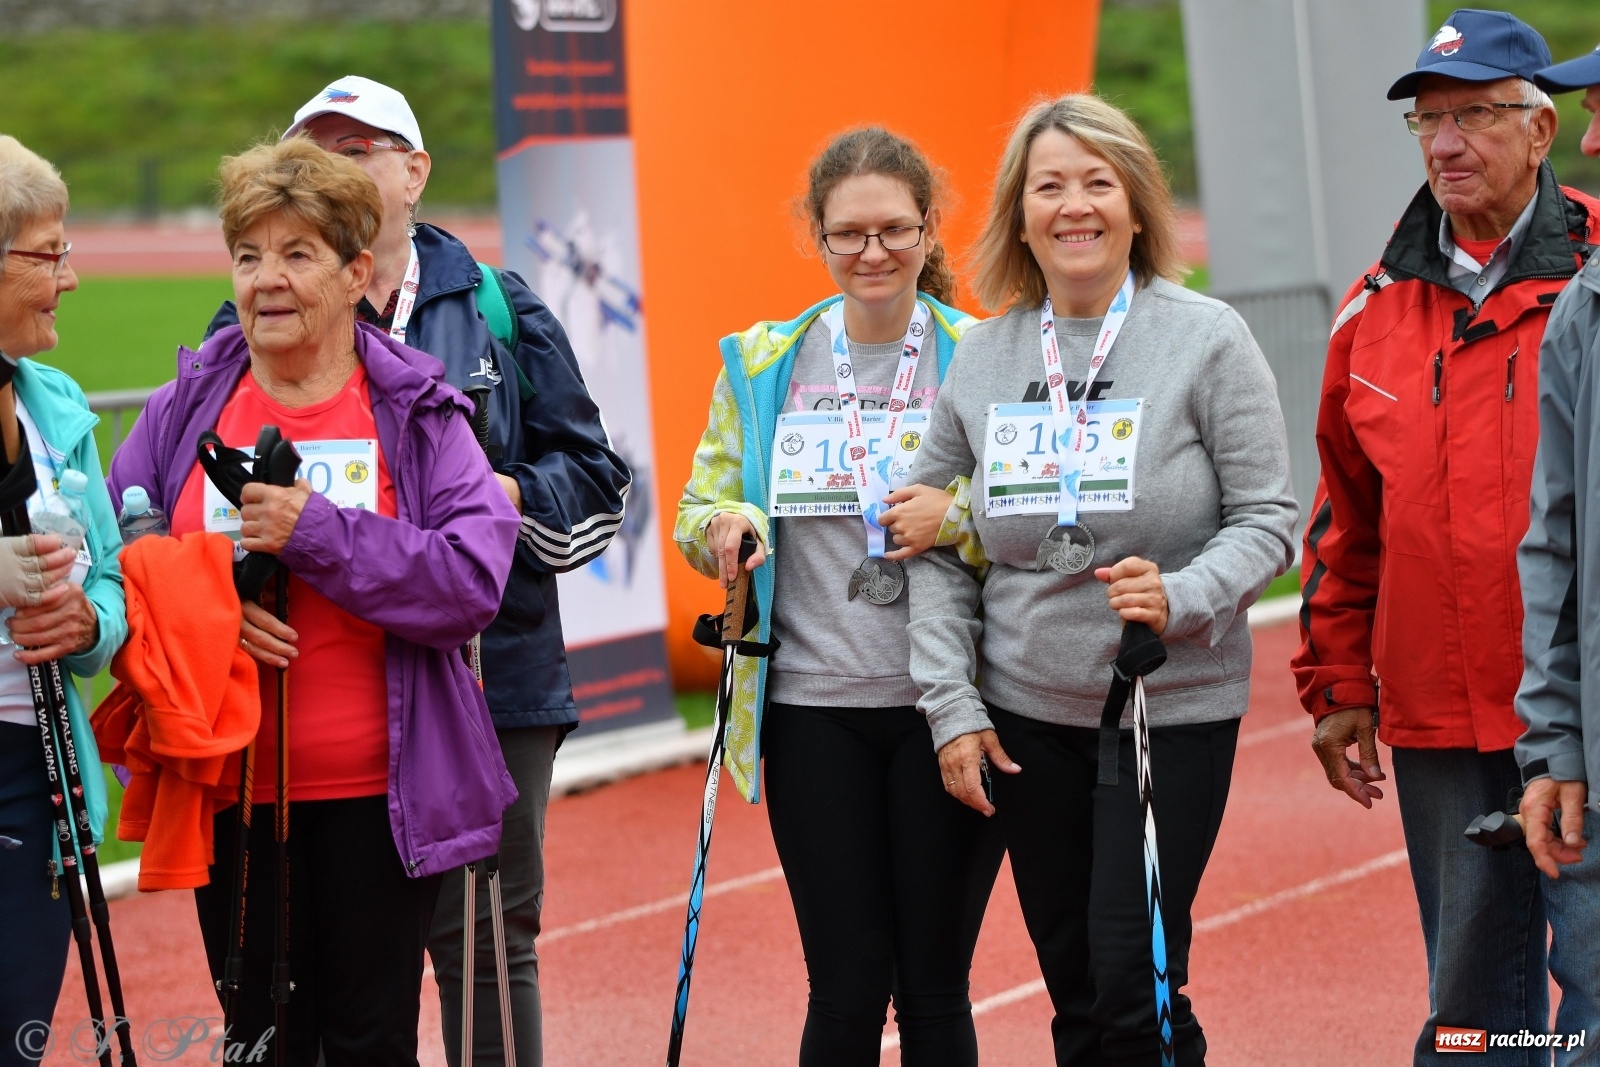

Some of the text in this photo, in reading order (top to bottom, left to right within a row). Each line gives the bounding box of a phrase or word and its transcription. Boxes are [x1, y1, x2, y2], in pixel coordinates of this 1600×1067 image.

[37, 708, 58, 782] WALKING
[58, 705, 79, 775] WALKING
[705, 761, 720, 824] NEATNESS
